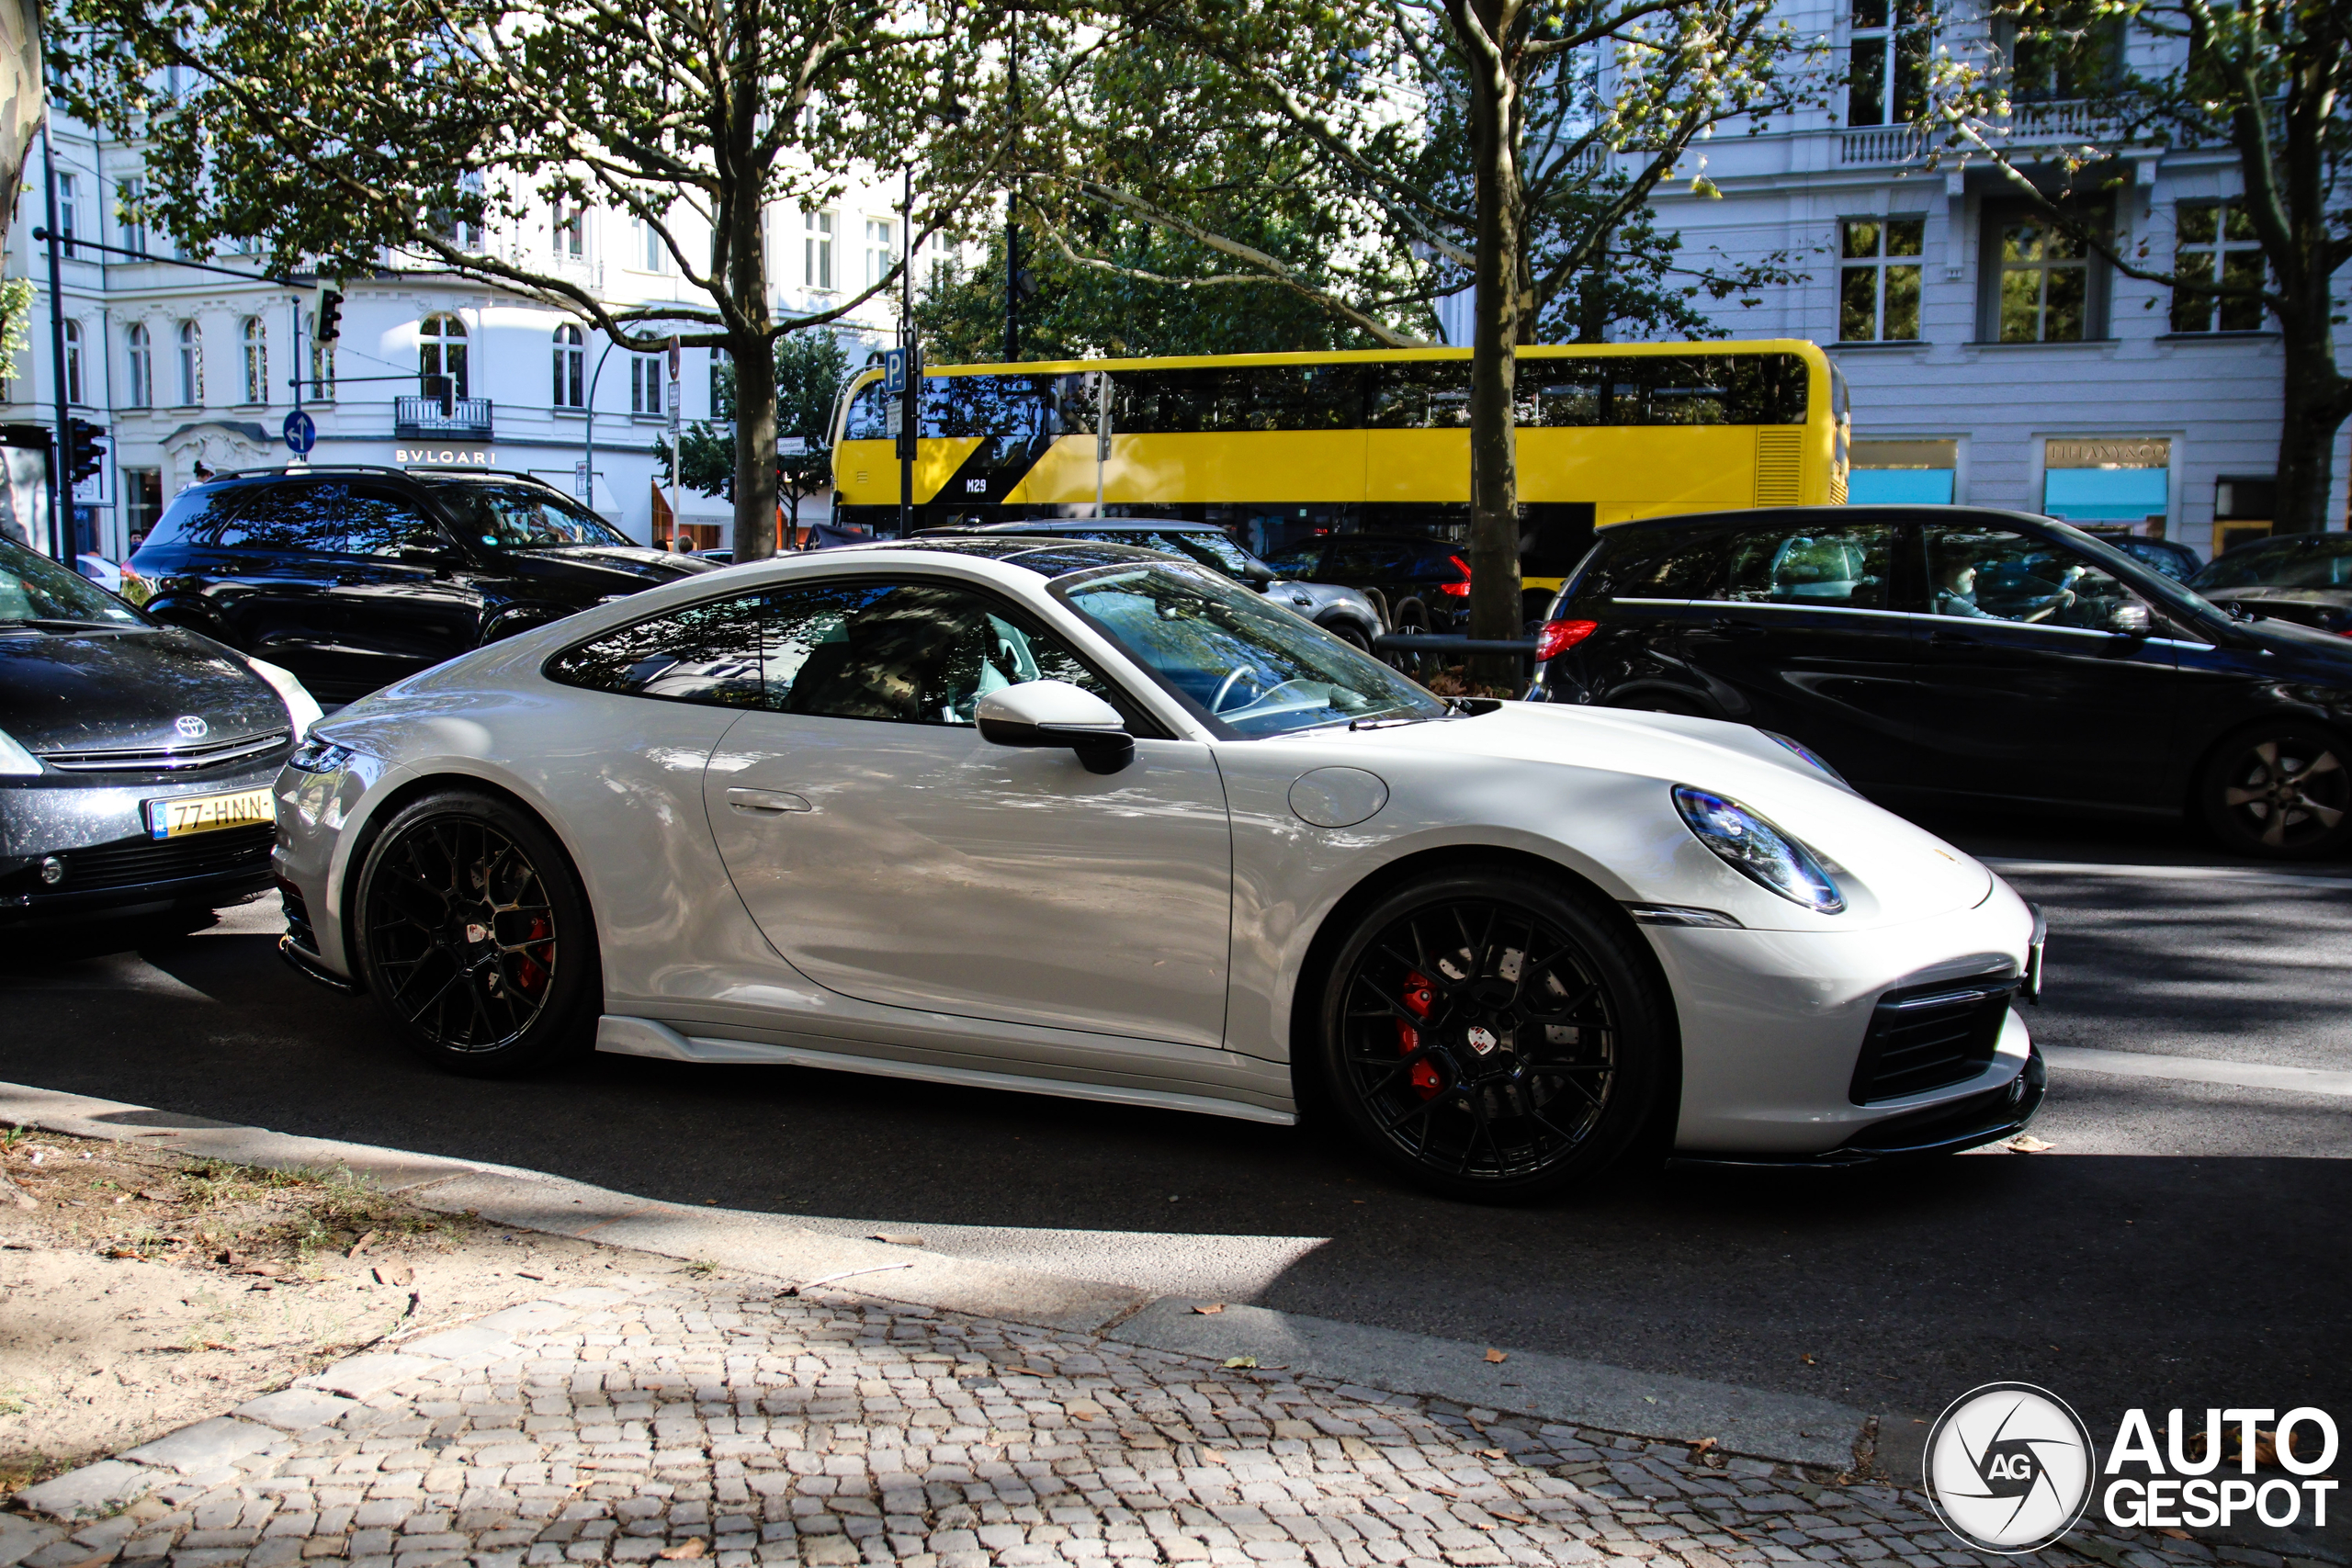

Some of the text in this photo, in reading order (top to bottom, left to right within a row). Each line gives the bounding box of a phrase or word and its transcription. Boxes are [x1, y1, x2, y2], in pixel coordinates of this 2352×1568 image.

[888, 354, 901, 387] P
[396, 450, 496, 465] BVLGARI
[967, 479, 987, 492] M29
